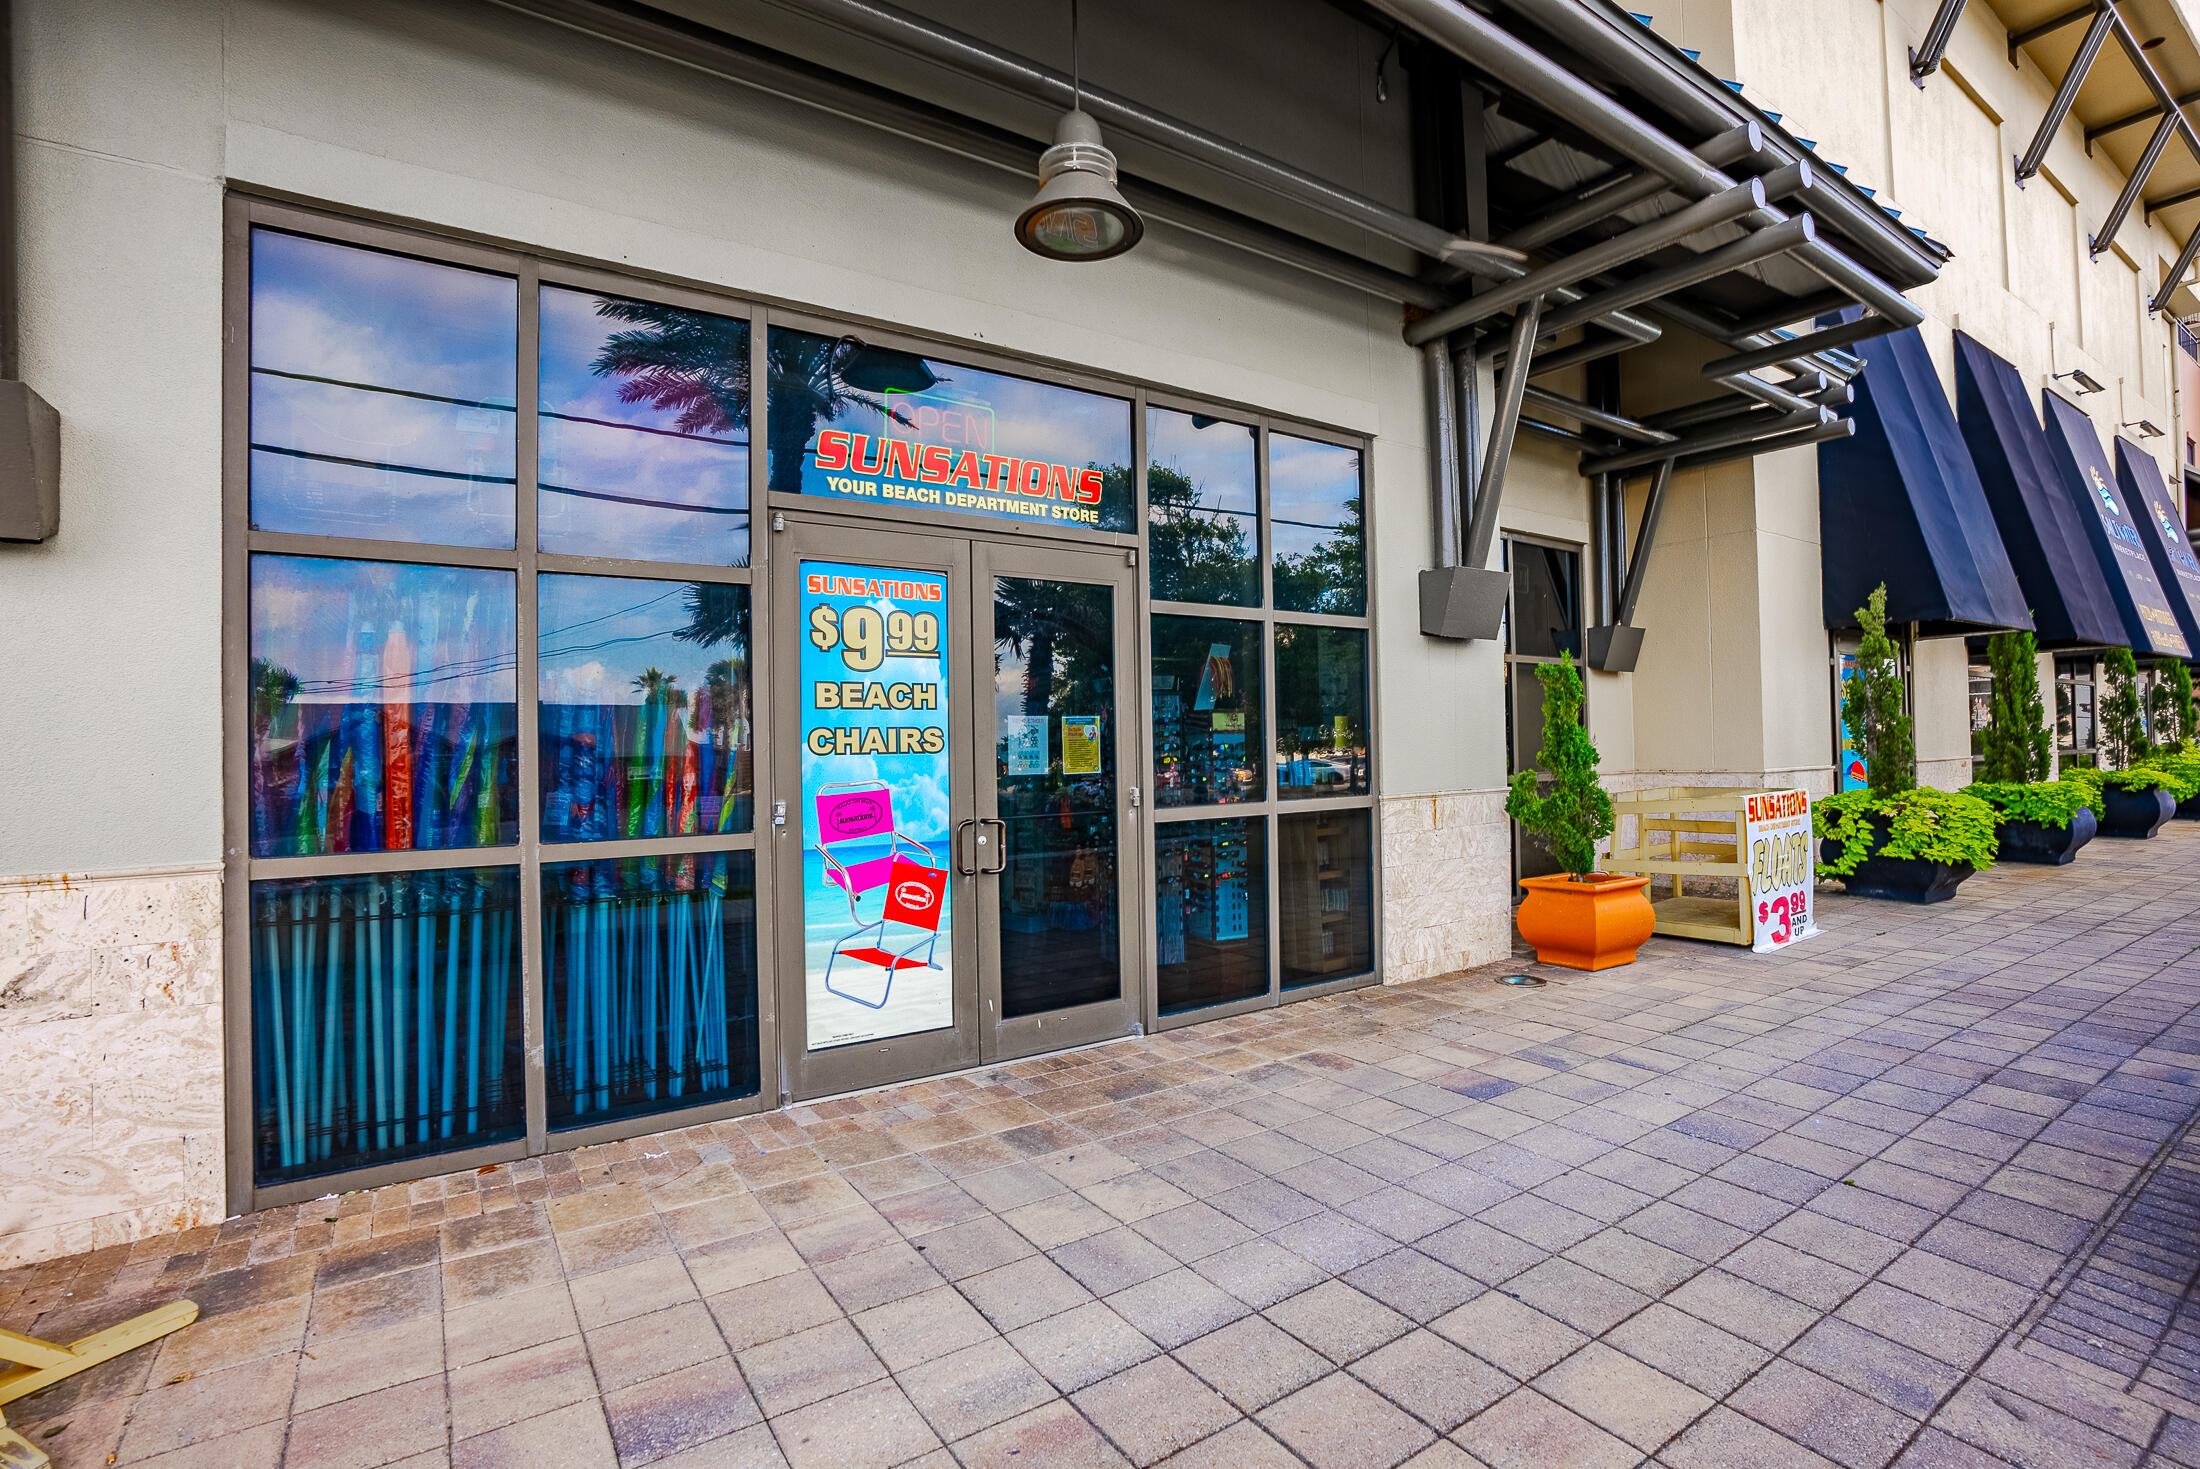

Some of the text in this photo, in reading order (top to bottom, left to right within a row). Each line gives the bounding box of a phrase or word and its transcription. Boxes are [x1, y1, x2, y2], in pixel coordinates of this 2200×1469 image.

[890, 401, 991, 450] OPEN
[815, 429, 1104, 505] SUNSATIONS
[826, 476, 1099, 524] YOUR BEACH DEPARTMENT STORE
[807, 575, 942, 602] SUNSATIONS
[814, 680, 938, 711] BEACH
[807, 727, 945, 756] CHAIRS
[1748, 791, 1807, 823] SUNSATIONS
[1752, 830, 1809, 896] FLOATS
[1791, 914, 1808, 927] AND
[1794, 926, 1805, 937] UP
